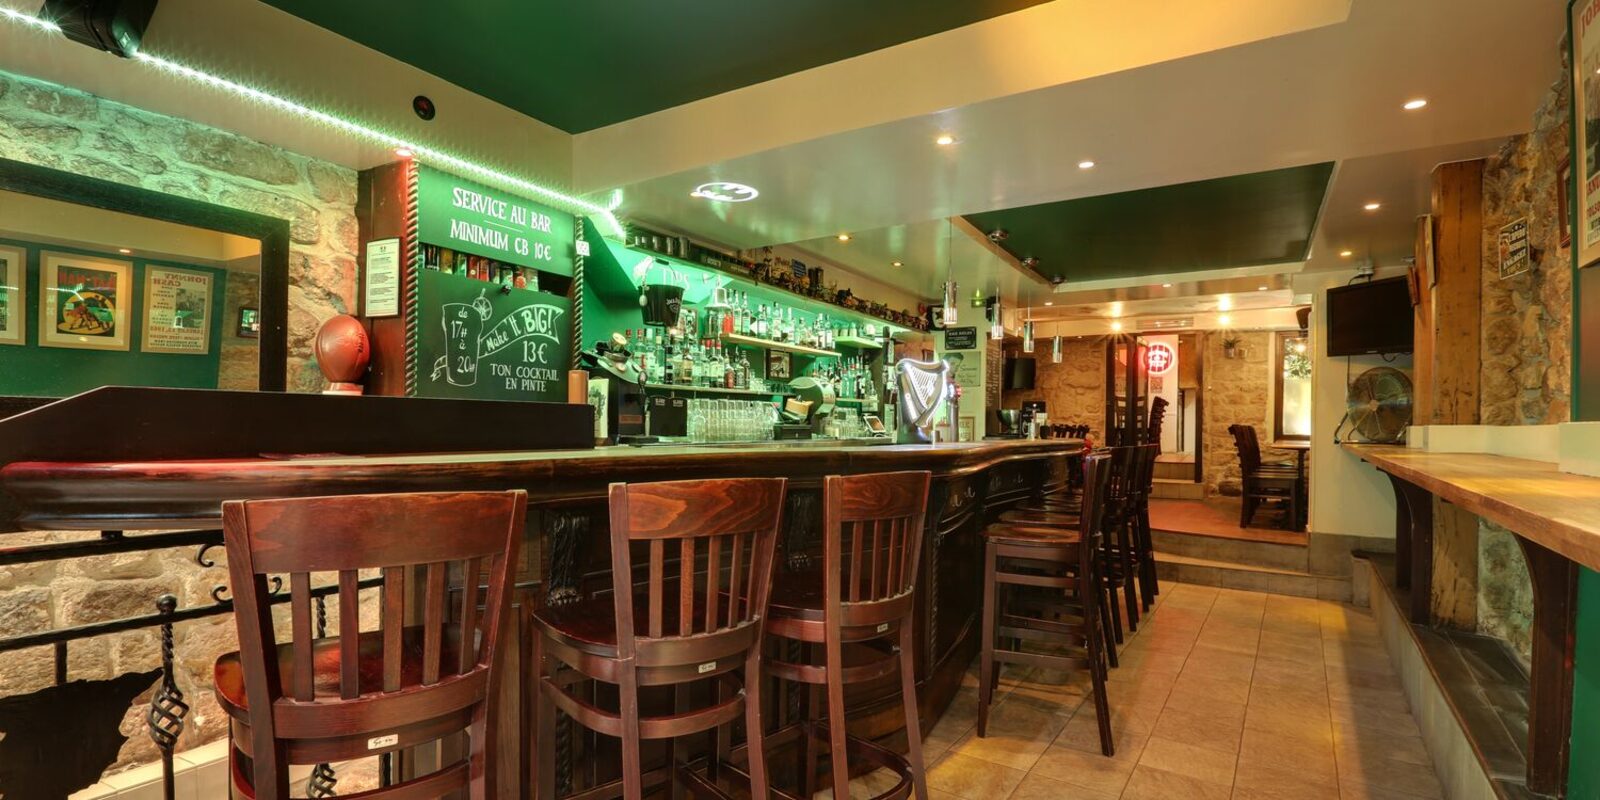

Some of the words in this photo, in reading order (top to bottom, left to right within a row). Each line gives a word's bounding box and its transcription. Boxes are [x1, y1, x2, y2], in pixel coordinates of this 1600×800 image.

[453, 187, 507, 220] SERVICE
[510, 205, 526, 226] AU
[531, 211, 552, 234] BAR
[450, 218, 509, 251] MINIMUM
[514, 237, 529, 256] CB
[534, 242, 552, 261] 10€
[458, 306, 468, 318] de
[486, 330, 509, 351] Make
[521, 306, 552, 336] BIG!
[522, 340, 548, 364] 13€
[490, 363, 511, 377] TON
[516, 366, 560, 381] COCKTAIL
[505, 377, 517, 390] EN
[521, 380, 547, 393] PINTE
